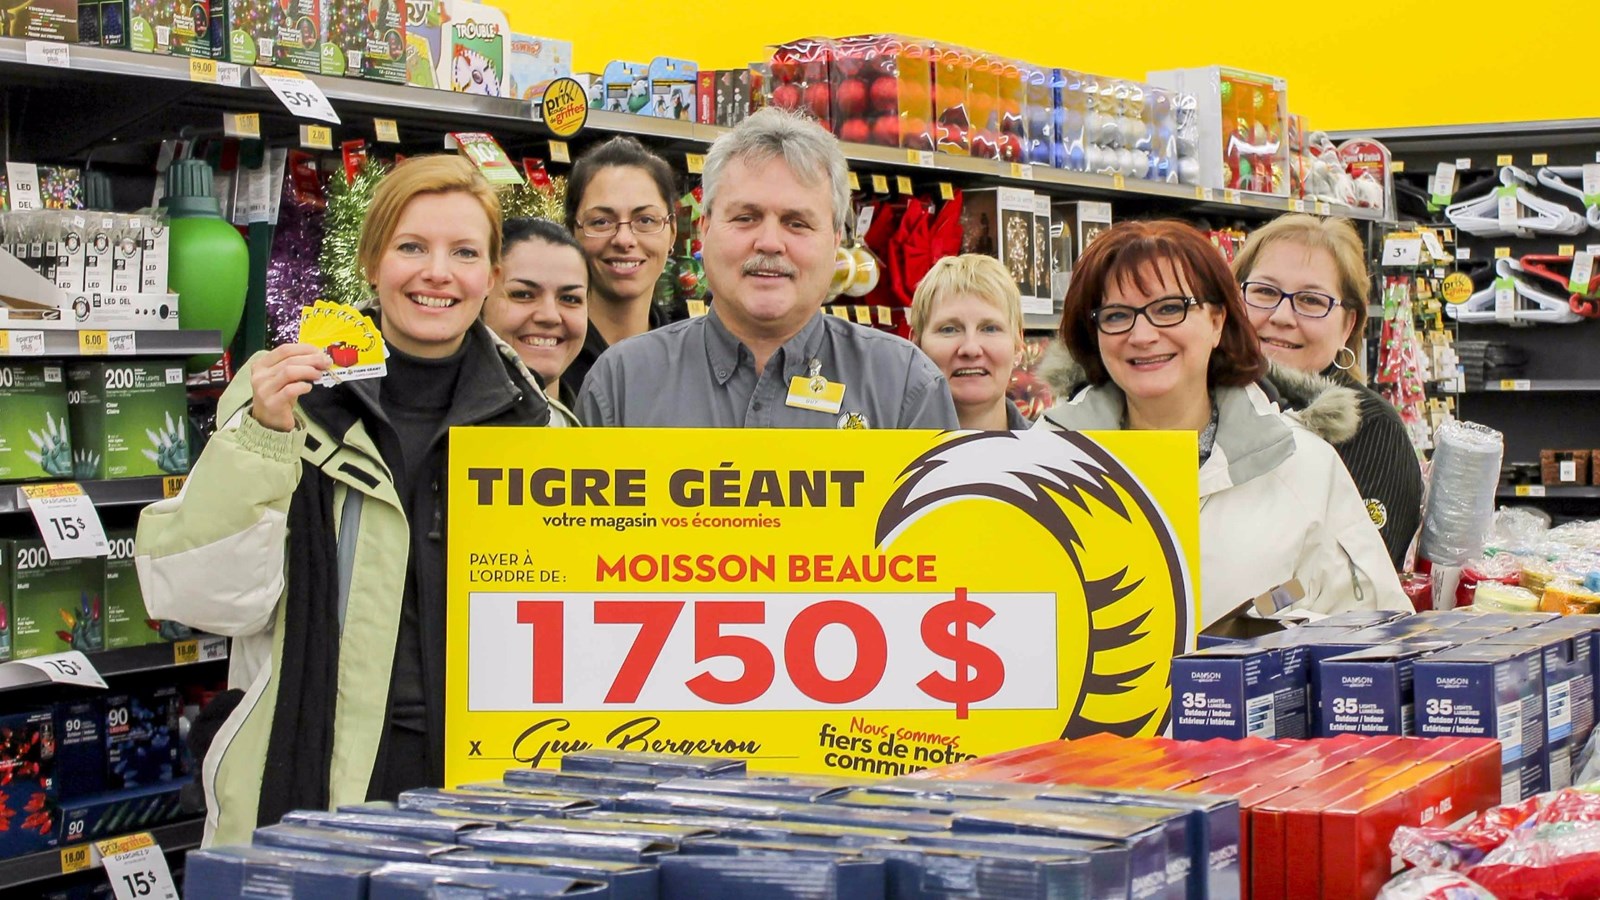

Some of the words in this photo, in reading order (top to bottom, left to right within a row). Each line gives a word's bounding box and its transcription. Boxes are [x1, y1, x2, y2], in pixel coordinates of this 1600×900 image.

[133, 22, 144, 32] 64
[233, 34, 244, 44] 64
[323, 47, 334, 57] 64
[192, 62, 212, 72] 69.00
[546, 89, 574, 116] prix
[556, 103, 584, 124] griffes
[312, 130, 324, 140] 2.00
[85, 335, 102, 344] 6.00
[106, 368, 134, 388] 200
[468, 467, 647, 507] TIGRE
[668, 462, 865, 508] GÉANT
[543, 514, 587, 528] votre
[590, 513, 658, 532] magasin
[660, 517, 689, 529] vos
[692, 512, 781, 529] économies
[107, 538, 134, 560] 200
[18, 548, 48, 569] 200
[470, 553, 520, 566] PAYER
[523, 549, 534, 566] À
[470, 569, 535, 583] L'ORDRE
[596, 554, 776, 584] MOISSON
[788, 554, 938, 582] BEAUCE
[916, 587, 1006, 720] $
[1192, 672, 1221, 680] DAMSON
[1436, 677, 1468, 685] DAMSON
[1182, 692, 1206, 708] 35
[1332, 698, 1358, 714] 35
[1426, 699, 1453, 715] 35
[108, 708, 128, 726] 90
[1184, 709, 1207, 717] Outdoor
[1335, 714, 1359, 722] Outdoor
[1364, 715, 1384, 723] Indoor
[1428, 716, 1454, 724] Outdoor
[1458, 716, 1480, 725] Indoor
[66, 719, 80, 731] 90
[850, 716, 890, 739] Nous
[896, 727, 961, 750] sommes
[606, 716, 762, 755] Bergeron
[819, 723, 872, 754] fiers
[878, 734, 908, 758] de
[69, 820, 84, 835] 90
[64, 850, 85, 863] 18.00
[122, 870, 156, 898] 15$
